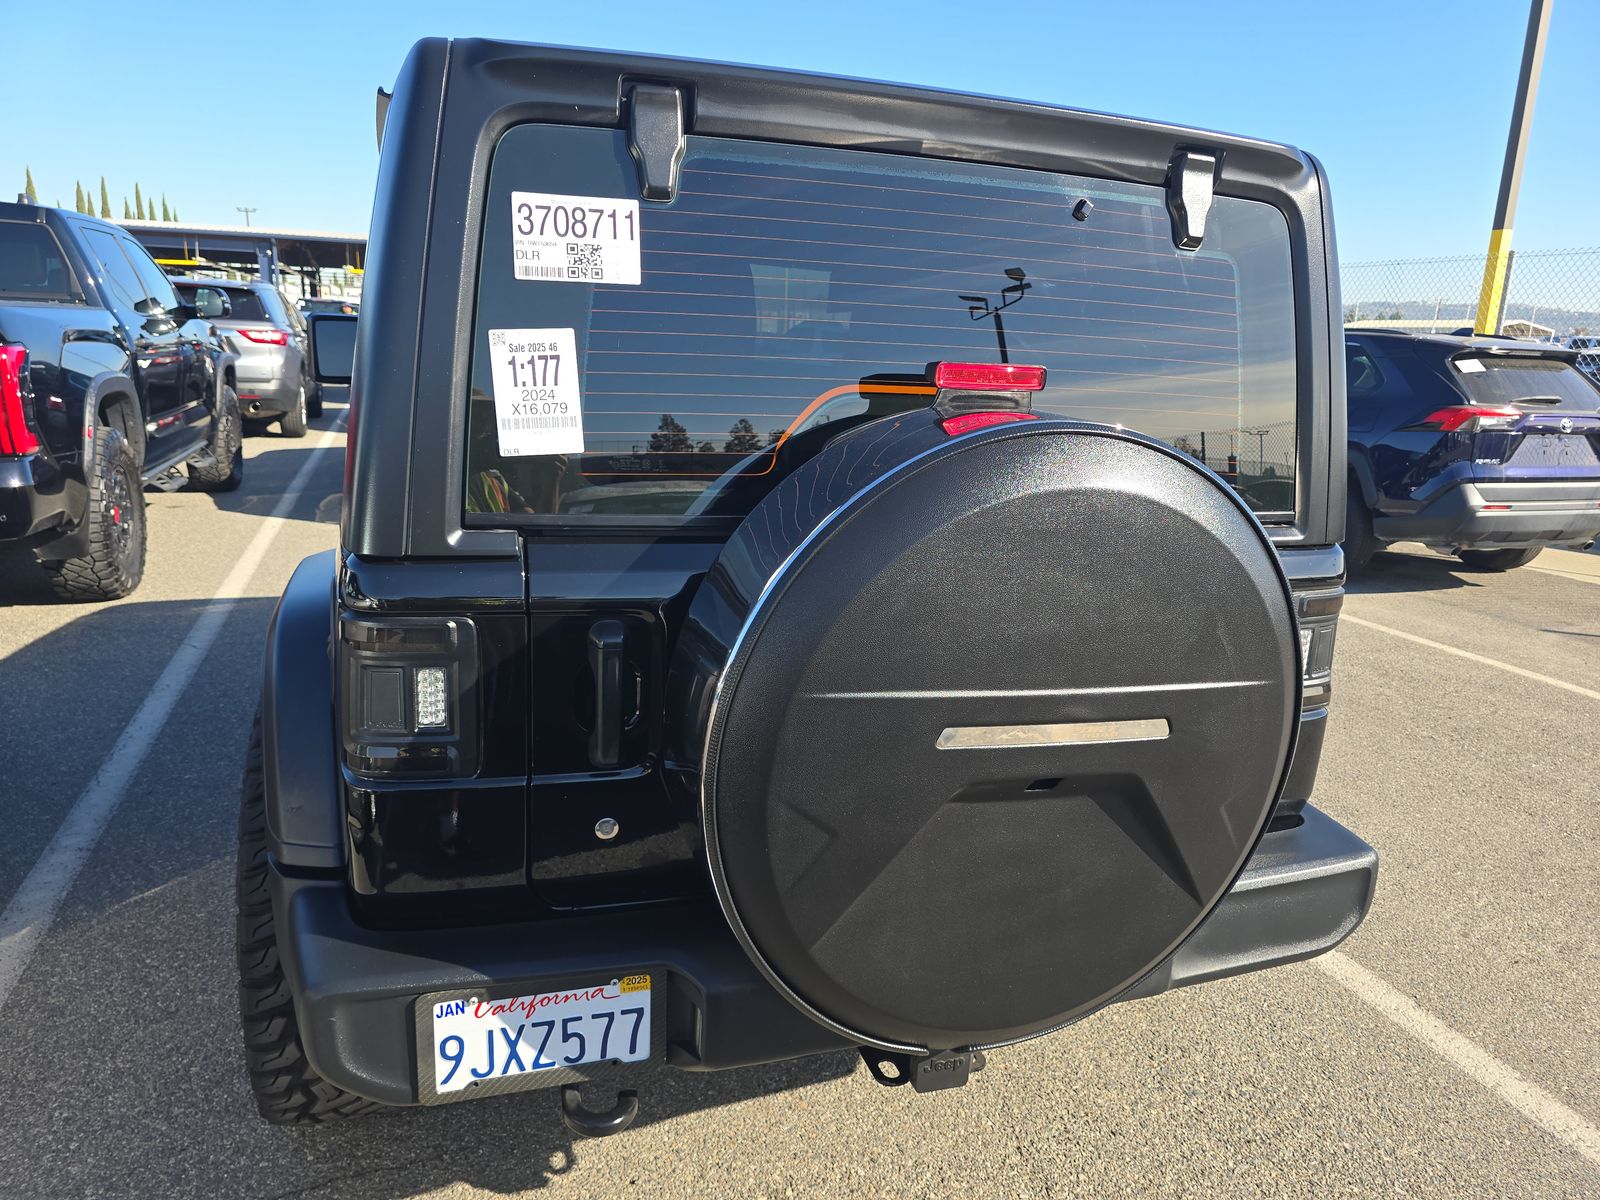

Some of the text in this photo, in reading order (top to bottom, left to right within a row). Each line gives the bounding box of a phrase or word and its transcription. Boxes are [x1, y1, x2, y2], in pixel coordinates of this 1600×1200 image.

[517, 203, 634, 241] 3708711
[515, 250, 540, 261] DLR
[508, 342, 558, 353] Sale 2025 46
[507, 354, 561, 387] 1:177
[521, 389, 555, 401] 2024
[511, 402, 568, 416] X16,079
[503, 448, 520, 456] DLR
[626, 975, 648, 986] 2025
[436, 1001, 466, 1019] JAN
[474, 985, 620, 1020] California
[439, 1007, 645, 1086] 9JXZ577
[923, 1056, 965, 1073] Jeep
